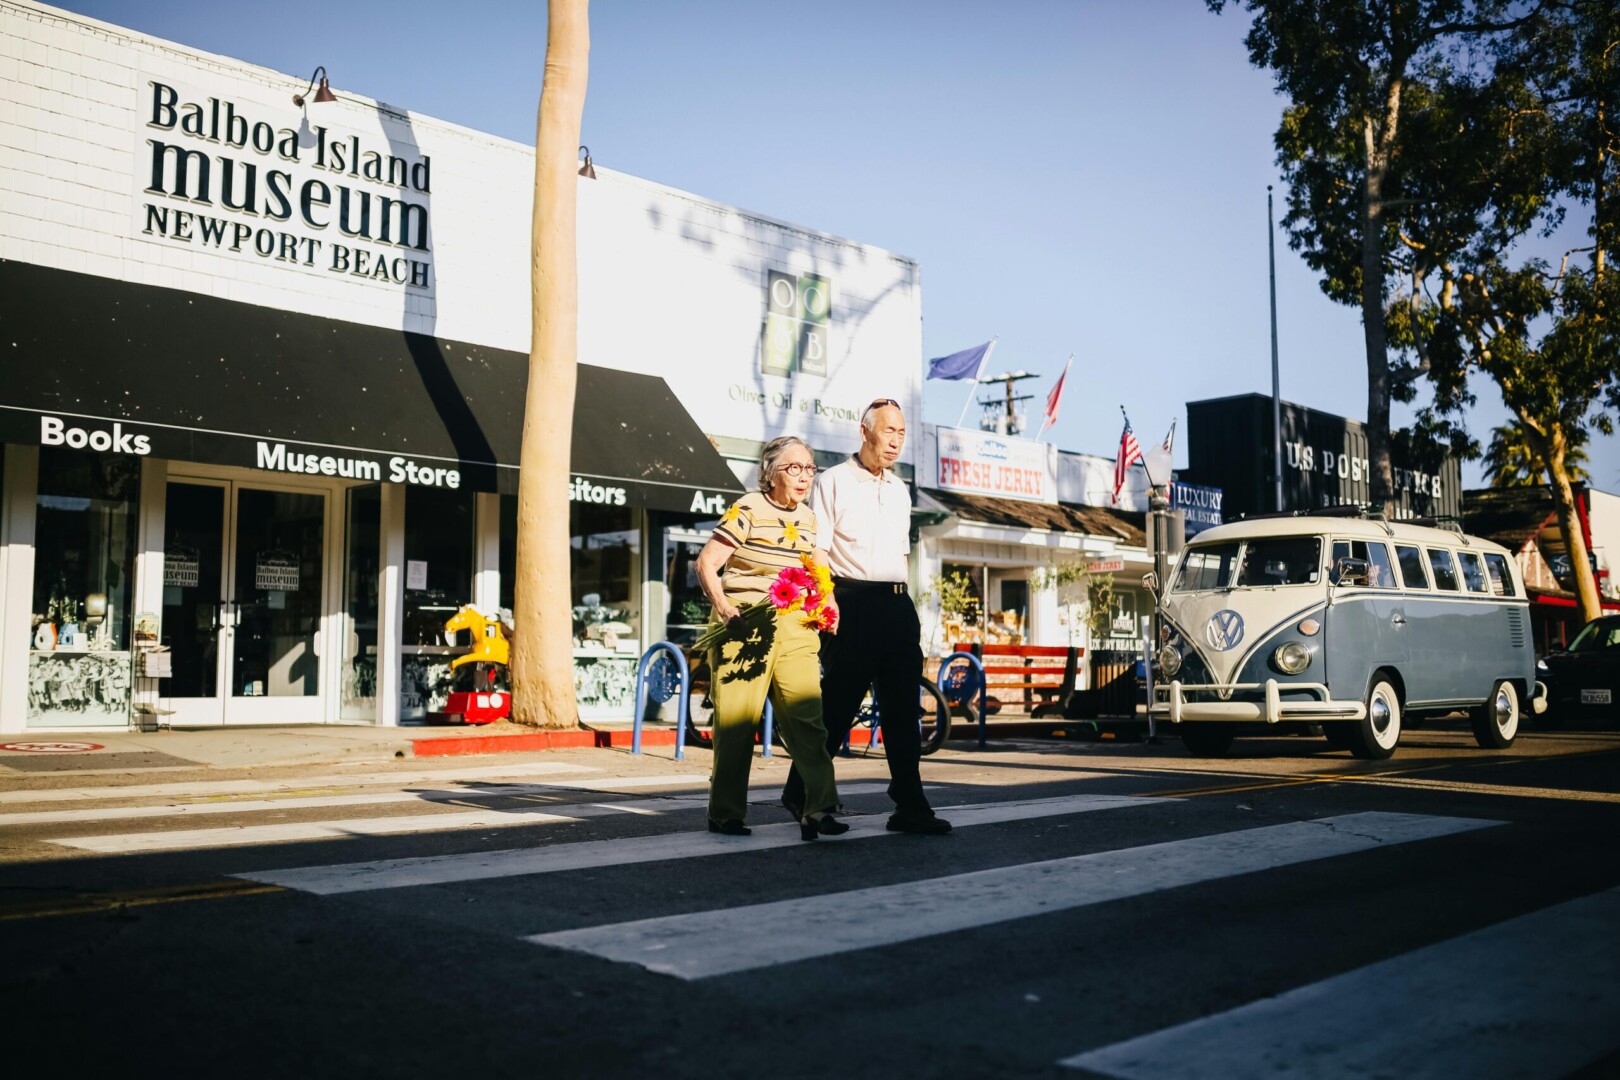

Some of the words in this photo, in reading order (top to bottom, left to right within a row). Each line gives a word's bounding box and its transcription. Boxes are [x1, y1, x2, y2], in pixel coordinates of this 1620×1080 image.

[146, 80, 301, 162] Balboa
[313, 125, 432, 195] Island
[143, 138, 430, 252] museum
[142, 203, 322, 268] NEWPORT
[329, 242, 430, 288] BEACH
[806, 331, 823, 360] B
[728, 384, 766, 405] Olive
[772, 391, 792, 410] Oil
[814, 398, 860, 423] Beyond
[41, 416, 151, 455] Books
[256, 441, 381, 482] Museum
[389, 456, 461, 489] Store
[940, 456, 992, 489] FRESH
[995, 465, 1042, 496] JERKY
[1285, 441, 1318, 472] U.S.
[1393, 466, 1442, 499] FFICE
[568, 477, 627, 506] sitors
[690, 491, 726, 515] Art
[1177, 485, 1223, 511] LUXURY
[164, 570, 197, 581] useum
[257, 575, 298, 585] museum
[1207, 609, 1245, 652] VW
